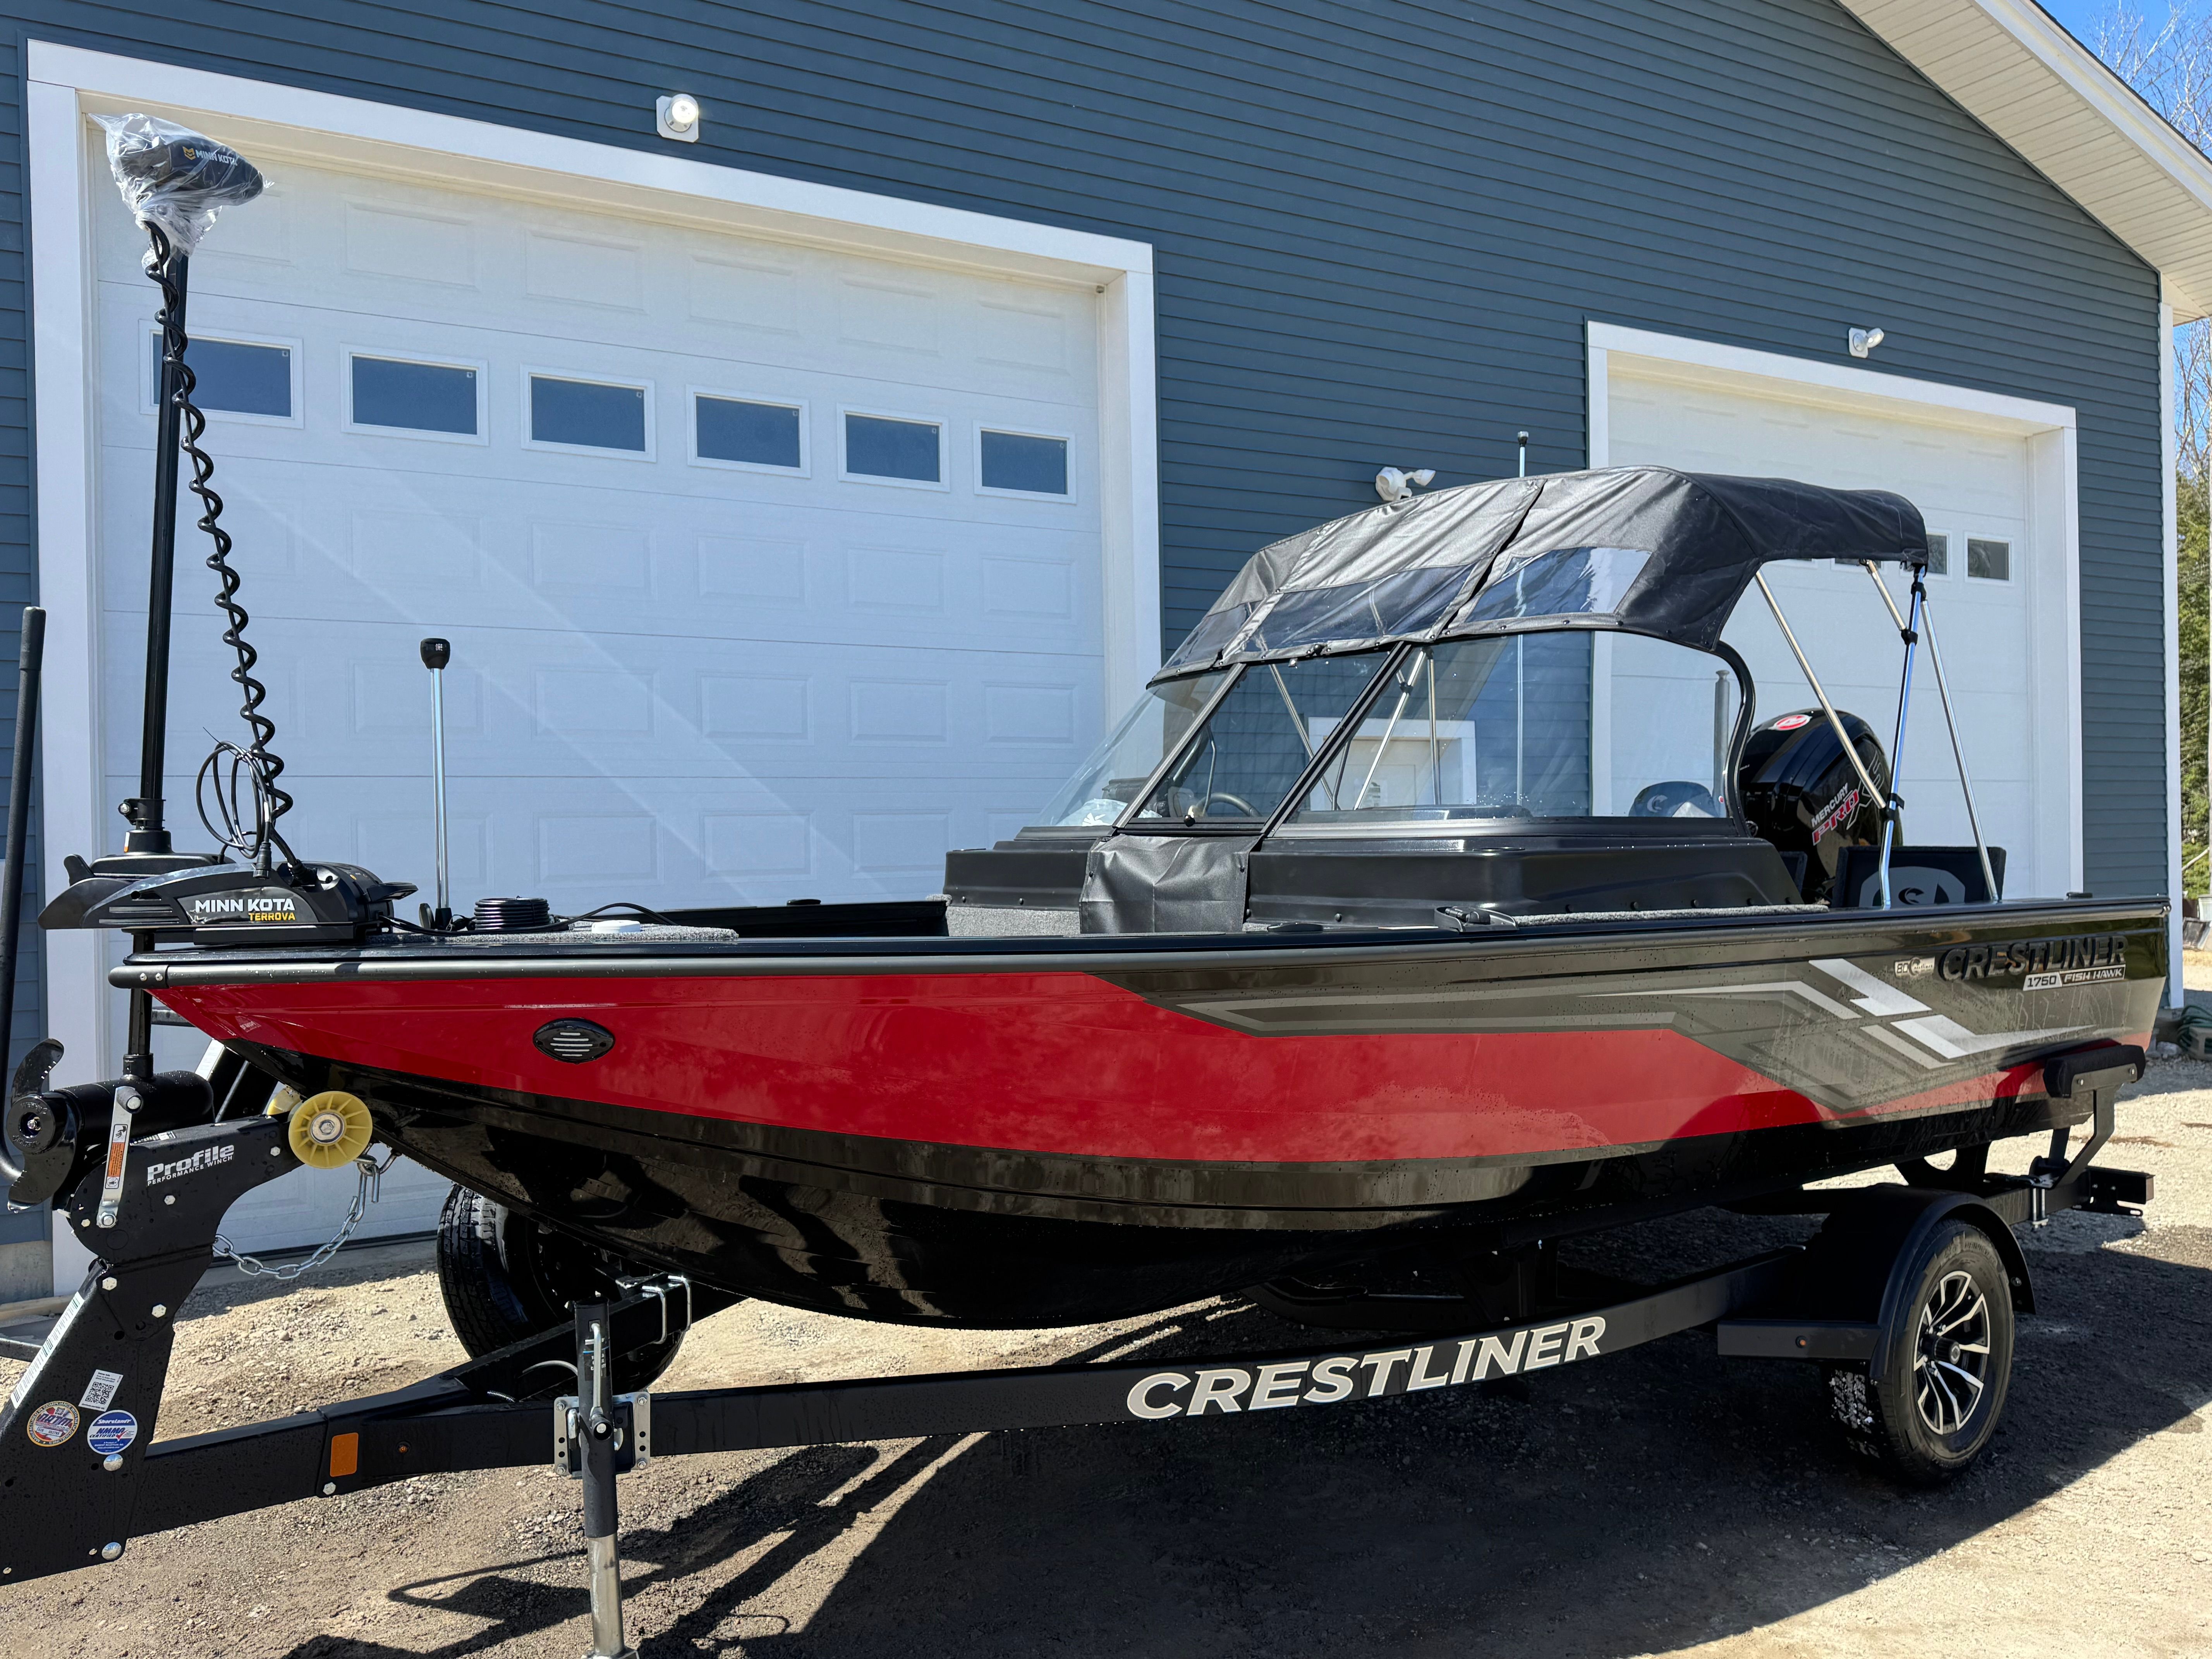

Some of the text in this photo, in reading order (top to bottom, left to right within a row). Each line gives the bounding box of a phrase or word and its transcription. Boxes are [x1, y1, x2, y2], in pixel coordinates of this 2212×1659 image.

[195, 149, 238, 166] MINN KOTA
[1811, 782, 1848, 828] MERCURY
[1812, 788, 1860, 846] PRO
[195, 898, 295, 913] MINN KOTA
[248, 912, 296, 922] TERROVA
[1939, 935, 2128, 981] CRESTLINER
[2027, 967, 2123, 987] 1750 FISH HAWK
[147, 1144, 234, 1181] Profile
[147, 1155, 233, 1186] PERFORMANCE WINCH
[1127, 1316, 1606, 1419] CRESTLINER
